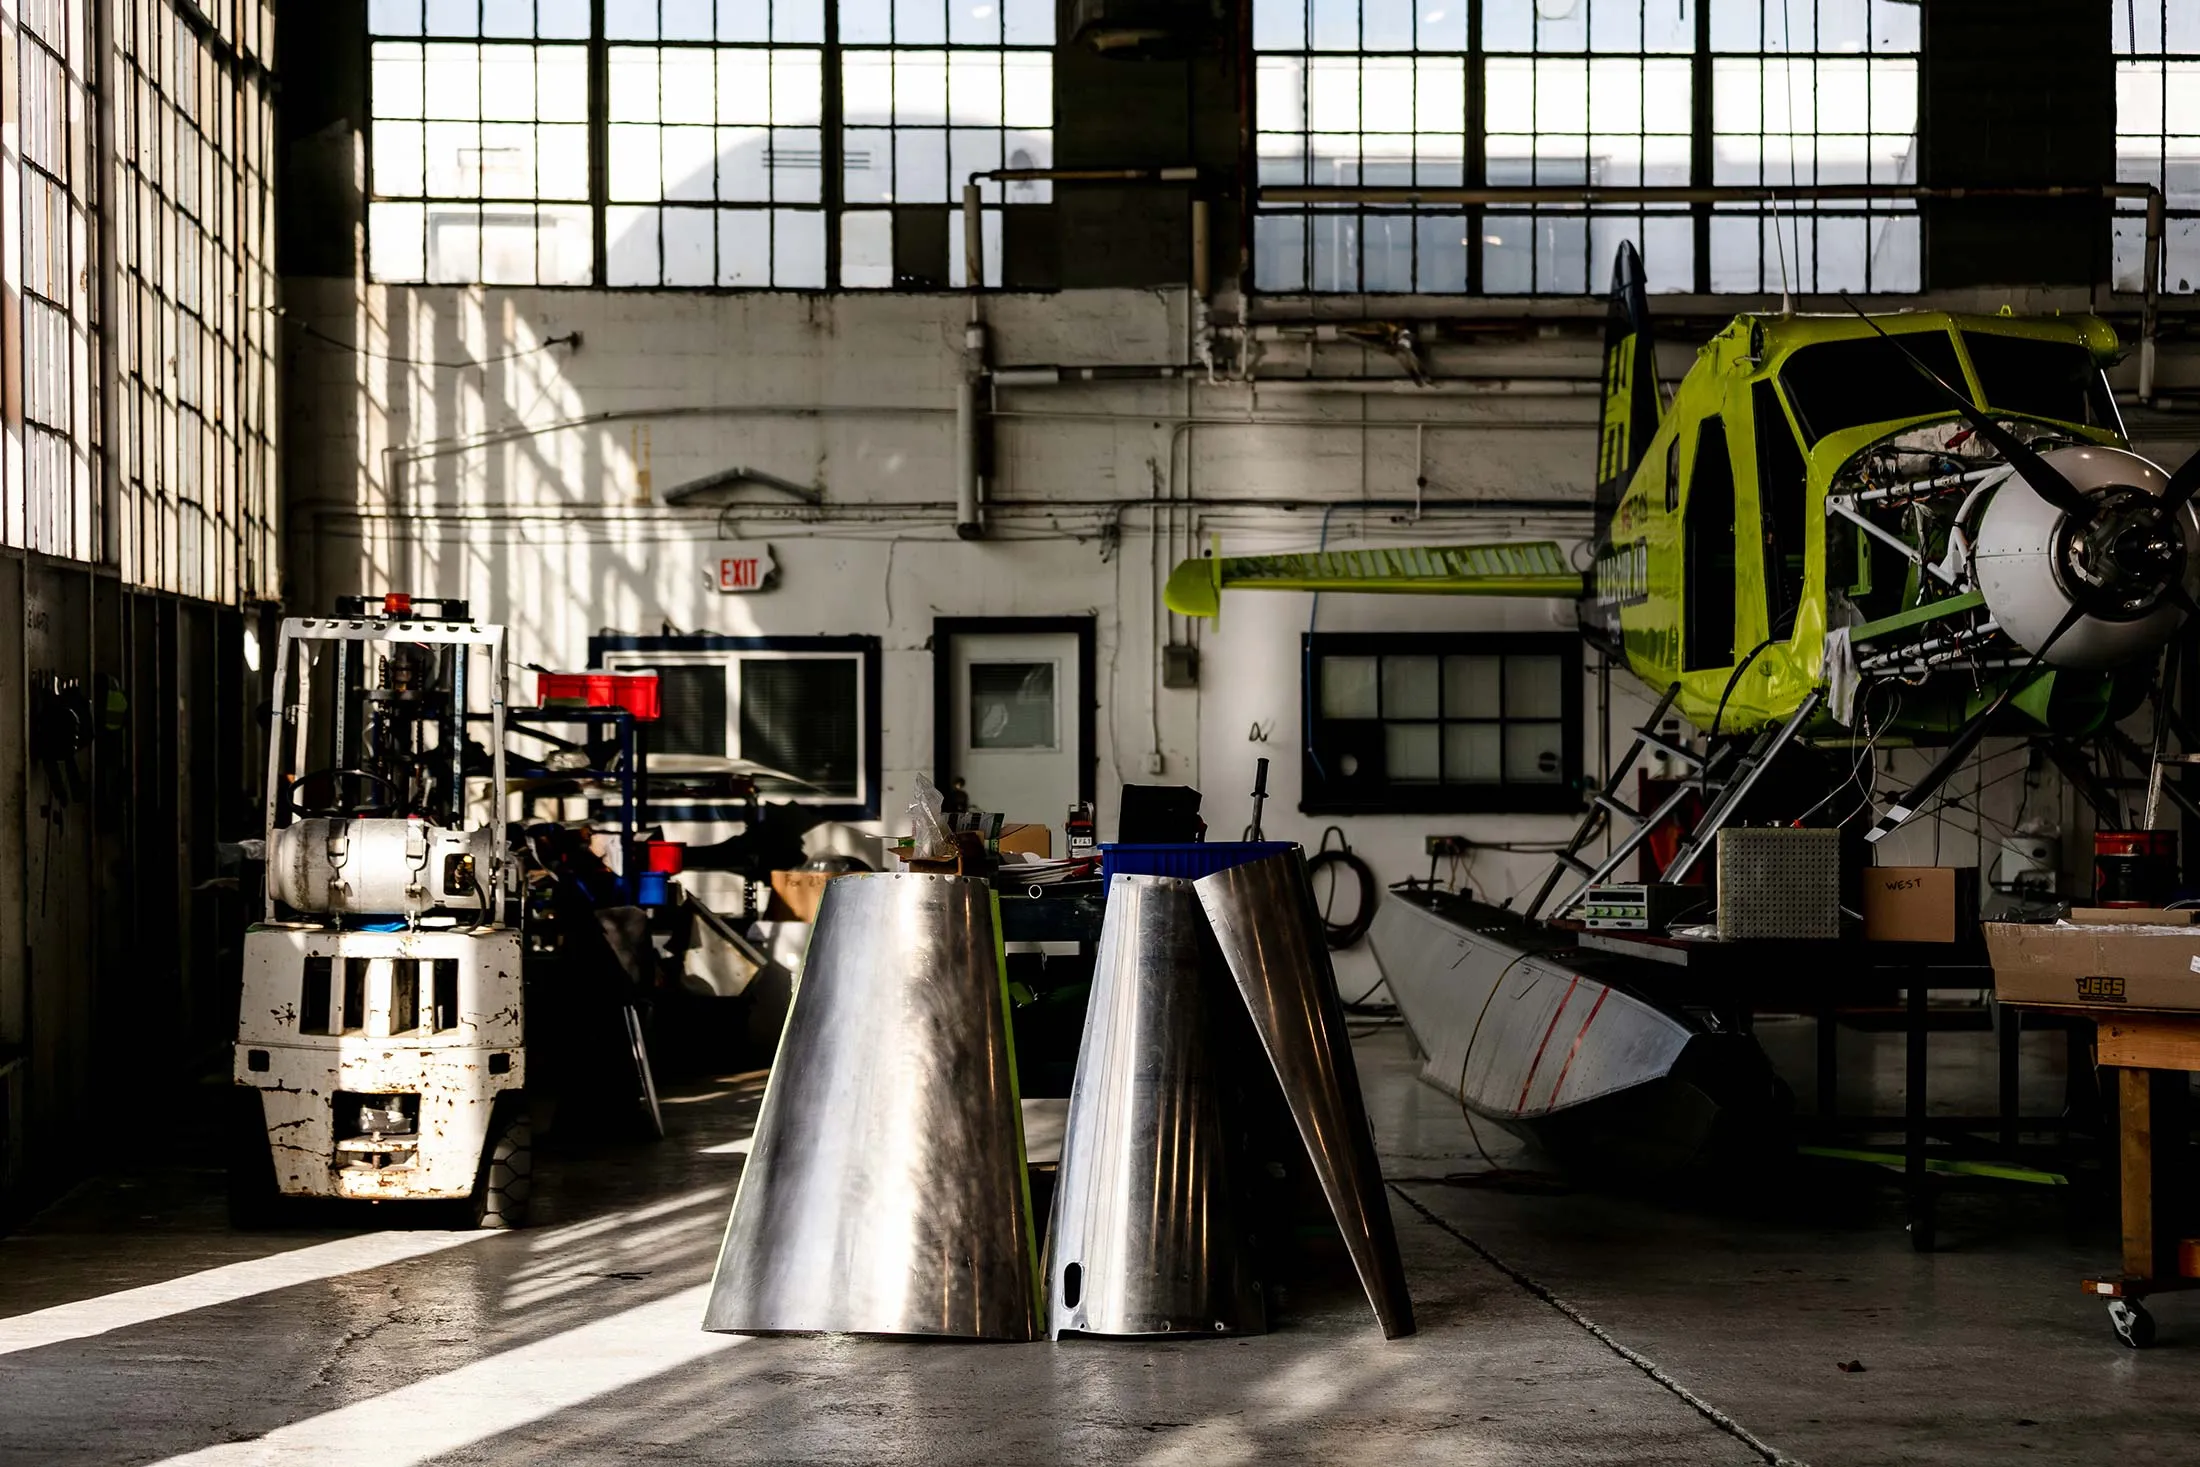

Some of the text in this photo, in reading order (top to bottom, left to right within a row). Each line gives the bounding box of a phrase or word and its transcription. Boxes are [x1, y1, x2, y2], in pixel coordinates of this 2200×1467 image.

[720, 558, 758, 587] EXIT
[1885, 878, 1921, 890] WEST
[2077, 977, 2124, 995] JEGS
